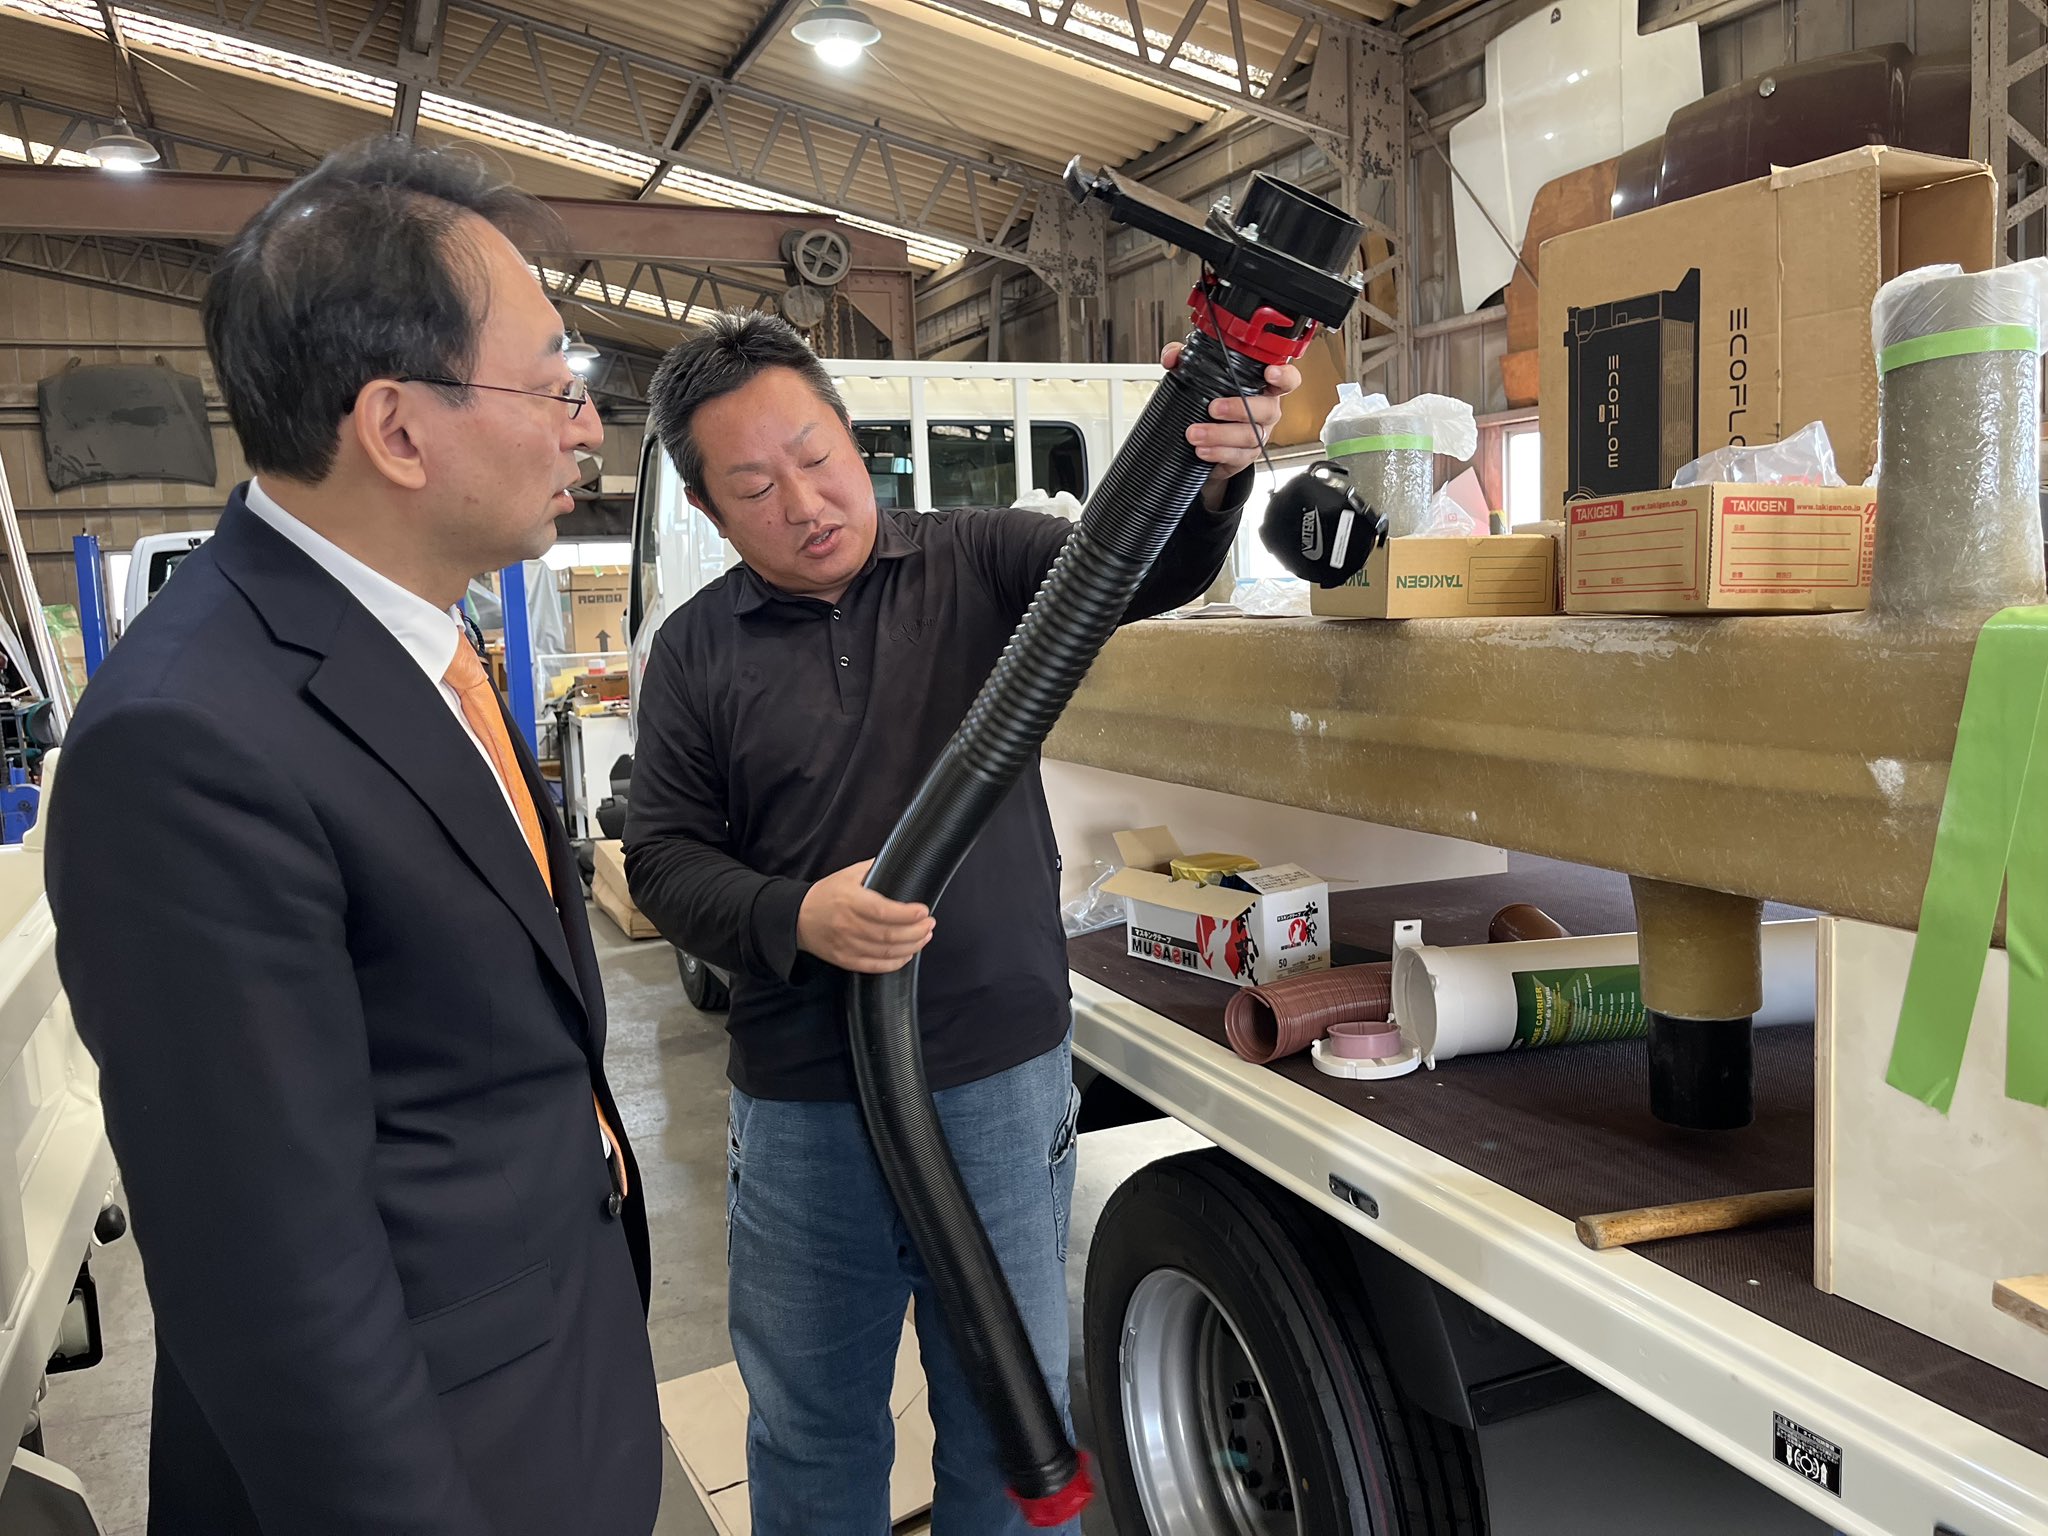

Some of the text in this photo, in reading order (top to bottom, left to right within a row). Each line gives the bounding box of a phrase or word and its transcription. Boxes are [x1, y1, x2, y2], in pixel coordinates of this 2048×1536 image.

[1608, 354, 1620, 468] ECOFLOW
[1576, 504, 1618, 521] TAKIGEN
[1730, 500, 1787, 513] TAKIGEN
[1796, 503, 1861, 512] www.takigen.co.jp
[1345, 569, 1370, 588] TAK
[1396, 574, 1463, 588] TAKIGEN
[1134, 928, 1172, 944] マスキングテープ
[1132, 938, 1199, 970] MUSASHI
[1279, 958, 1287, 968] 50
[1535, 986, 1544, 1026] CARRIER
